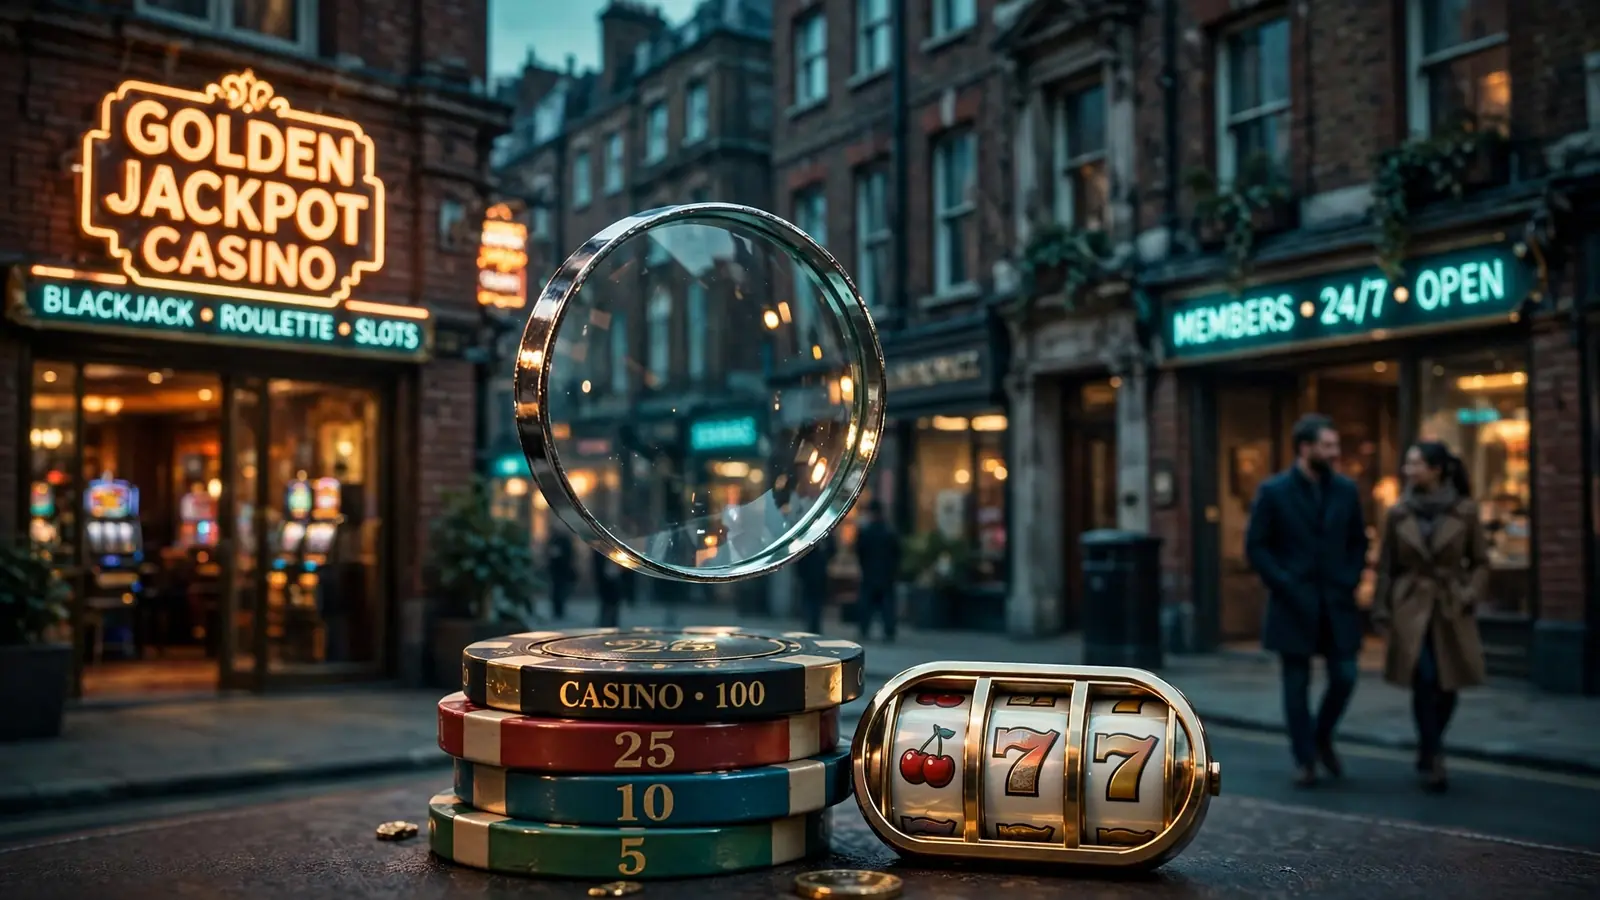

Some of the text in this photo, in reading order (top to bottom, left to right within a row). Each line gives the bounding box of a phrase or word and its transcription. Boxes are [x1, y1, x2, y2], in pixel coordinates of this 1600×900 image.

[126, 101, 354, 186] GOLDEN
[105, 160, 369, 245] JACKPOT
[143, 226, 336, 291] CASINO
[43, 286, 419, 350] BLACKJACK ROULETTE SLOTS
[1173, 259, 1505, 347] MEMBERS 24/7 OPEN
[559, 680, 765, 710] CASINO 100
[614, 730, 675, 769] 25
[992, 726, 1160, 803] 7 7
[617, 784, 674, 822] 10
[618, 837, 646, 876] 5
